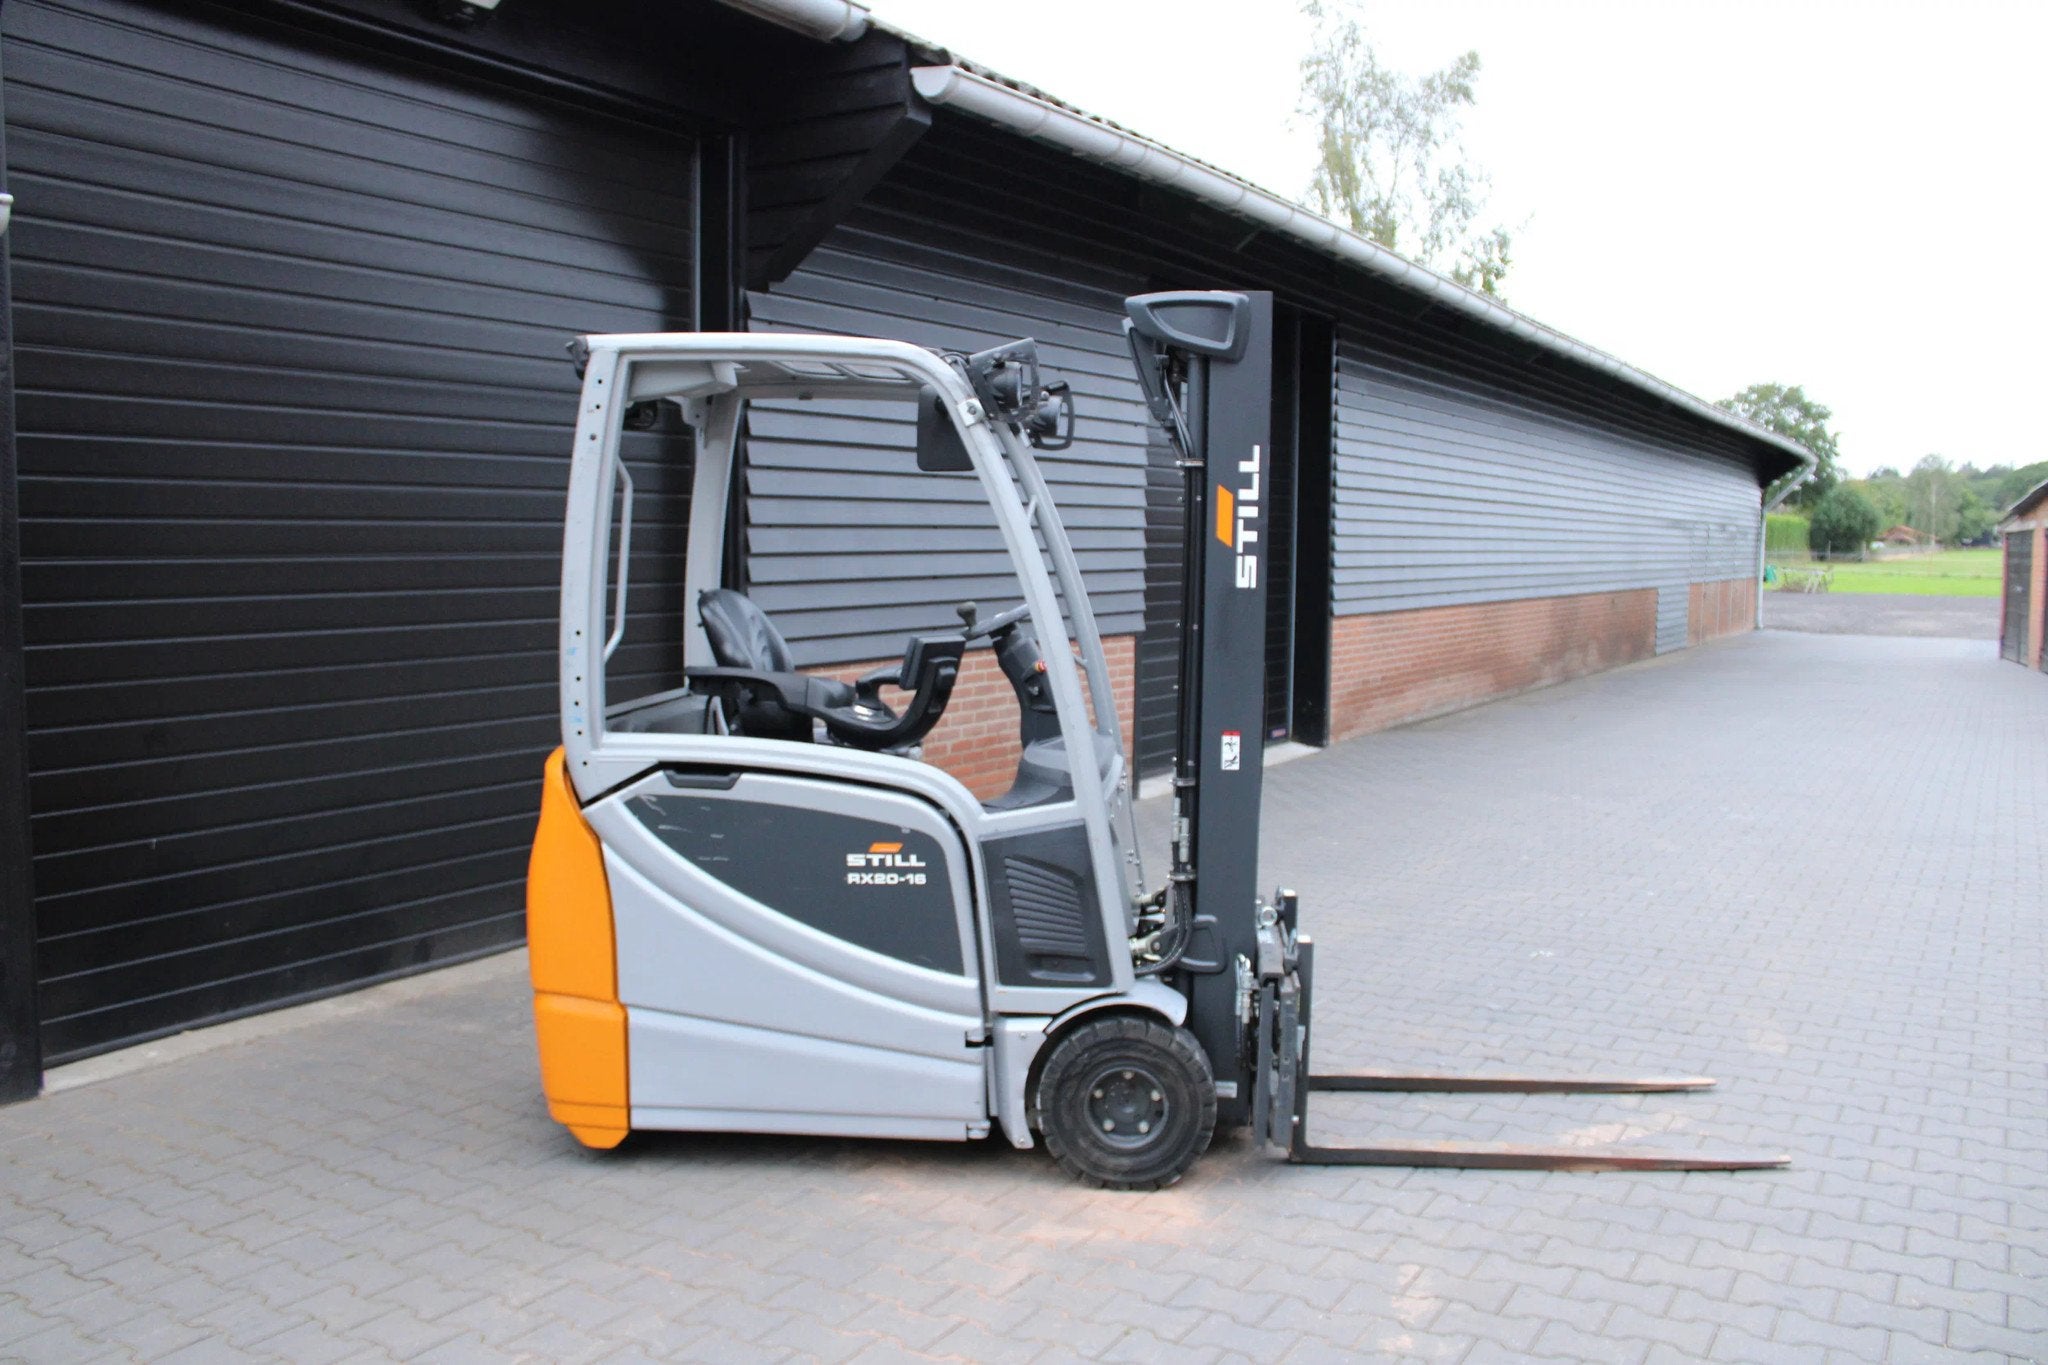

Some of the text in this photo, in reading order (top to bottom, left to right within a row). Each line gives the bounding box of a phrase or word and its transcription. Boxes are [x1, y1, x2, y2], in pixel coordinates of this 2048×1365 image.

[1235, 444, 1261, 590] STILL
[846, 853, 926, 867] STILL
[846, 872, 927, 885] RX20-16
